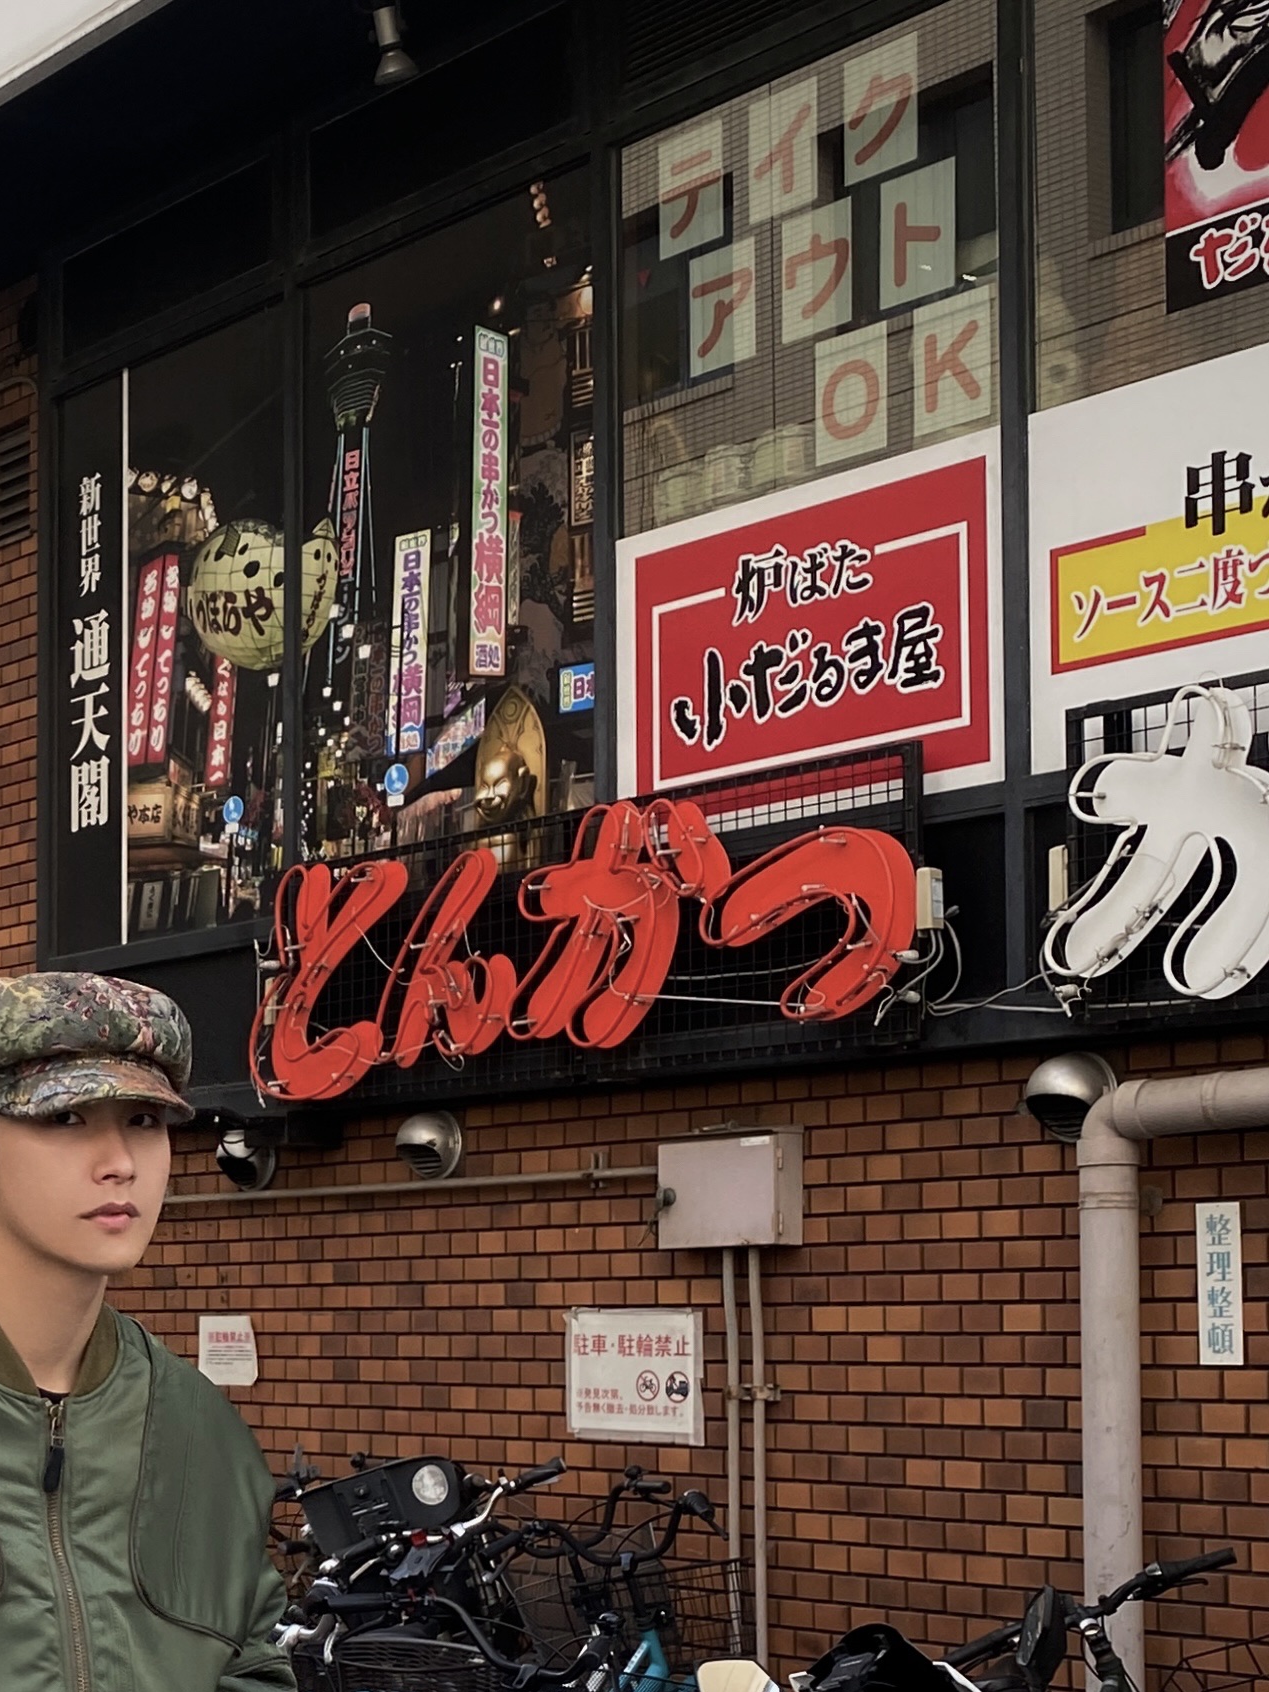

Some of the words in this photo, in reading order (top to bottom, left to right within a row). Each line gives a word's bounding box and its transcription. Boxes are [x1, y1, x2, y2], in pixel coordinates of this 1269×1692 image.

[691, 201, 942, 359] アウト
[821, 319, 983, 441] OK
[79, 472, 102, 598] 新世界
[1184, 450, 1269, 536] 串
[735, 543, 870, 623] 炉ばた
[69, 608, 111, 833] 通天閣
[672, 602, 944, 748] 小だるま屋
[249, 798, 918, 1101] とんかつ
[1205, 1213, 1234, 1355] 整理整頓
